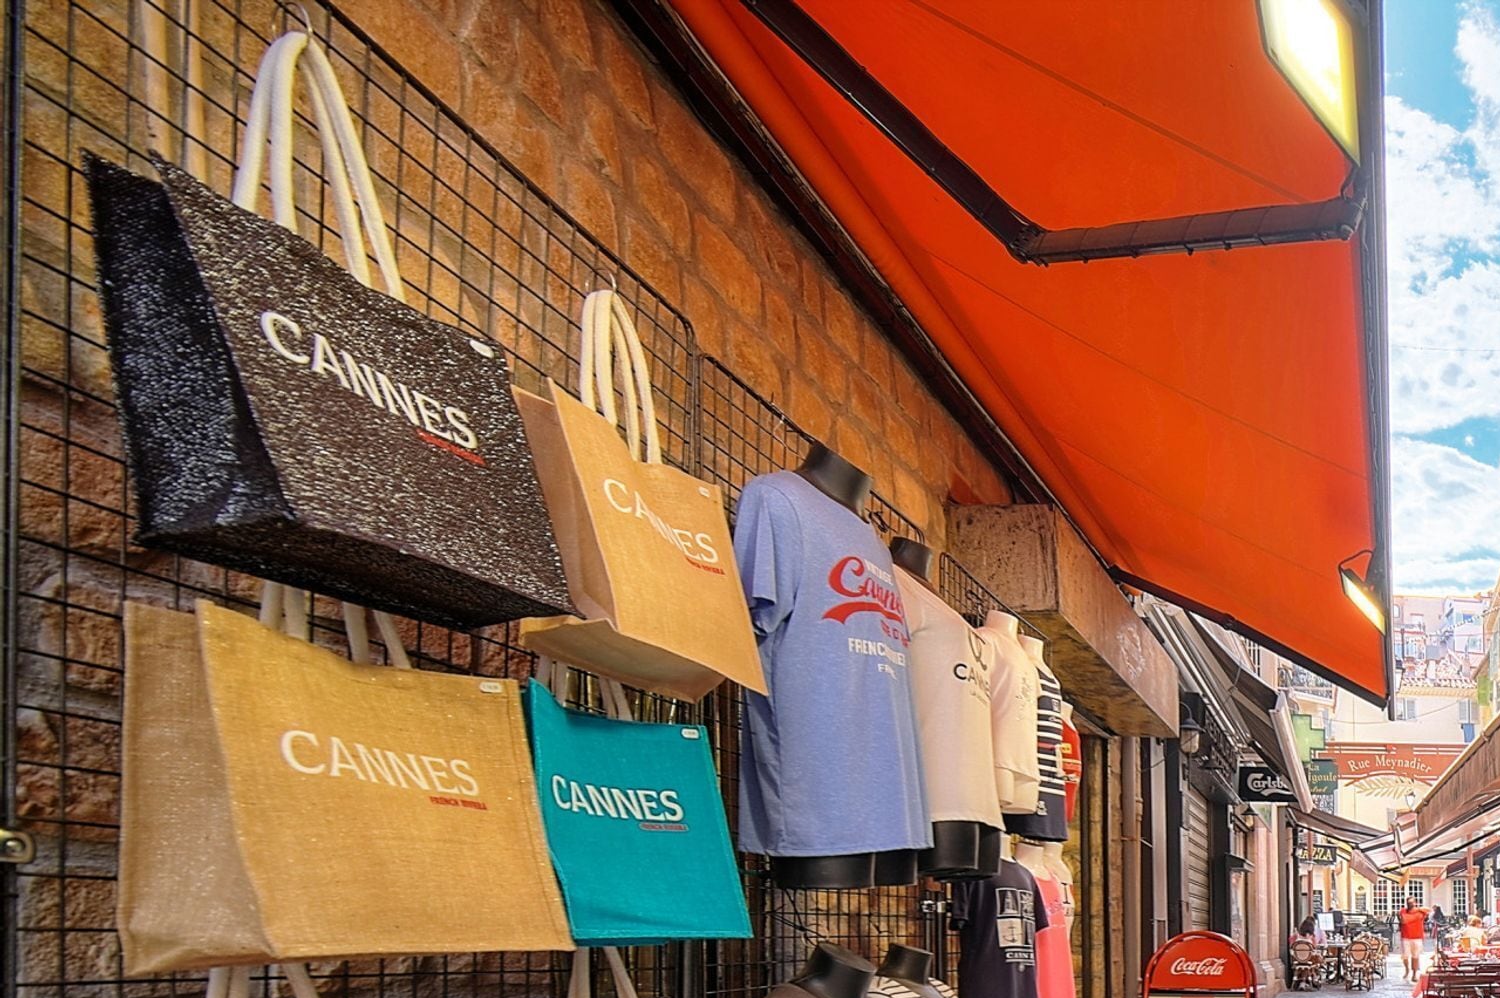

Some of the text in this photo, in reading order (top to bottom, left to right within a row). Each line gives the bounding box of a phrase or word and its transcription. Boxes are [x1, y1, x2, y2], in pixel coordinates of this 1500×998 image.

[261, 311, 478, 449] CANNES
[282, 730, 479, 796] CANNES
[1348, 755, 1432, 773] Rue Meynadier
[552, 774, 684, 821] CANNES
[1247, 772, 1289, 792] Carlsb
[1170, 957, 1228, 976] Coca-Cola
